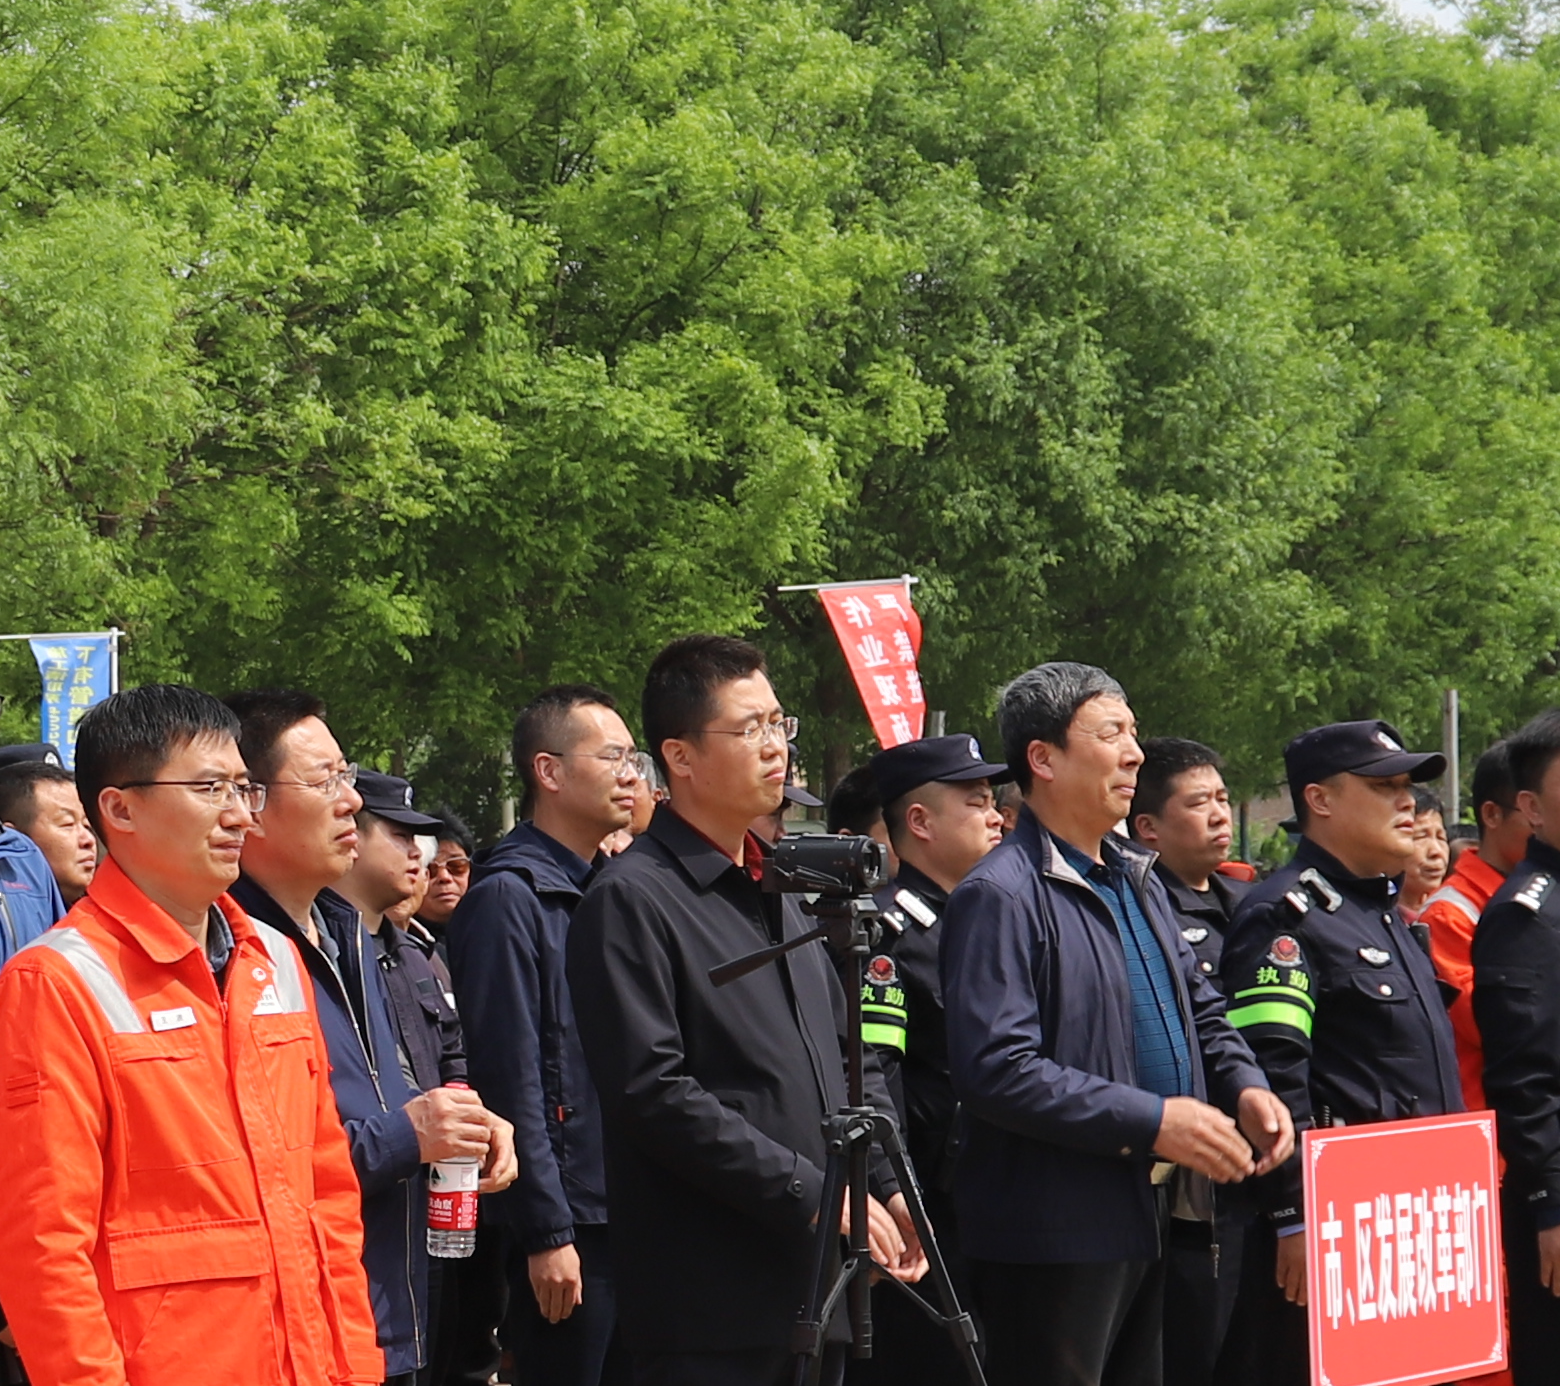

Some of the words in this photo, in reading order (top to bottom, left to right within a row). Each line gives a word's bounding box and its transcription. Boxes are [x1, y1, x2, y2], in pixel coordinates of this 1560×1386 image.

[1256, 965, 1309, 991] 执勤
[1320, 1181, 1493, 1331] 市、区发展改革部门
